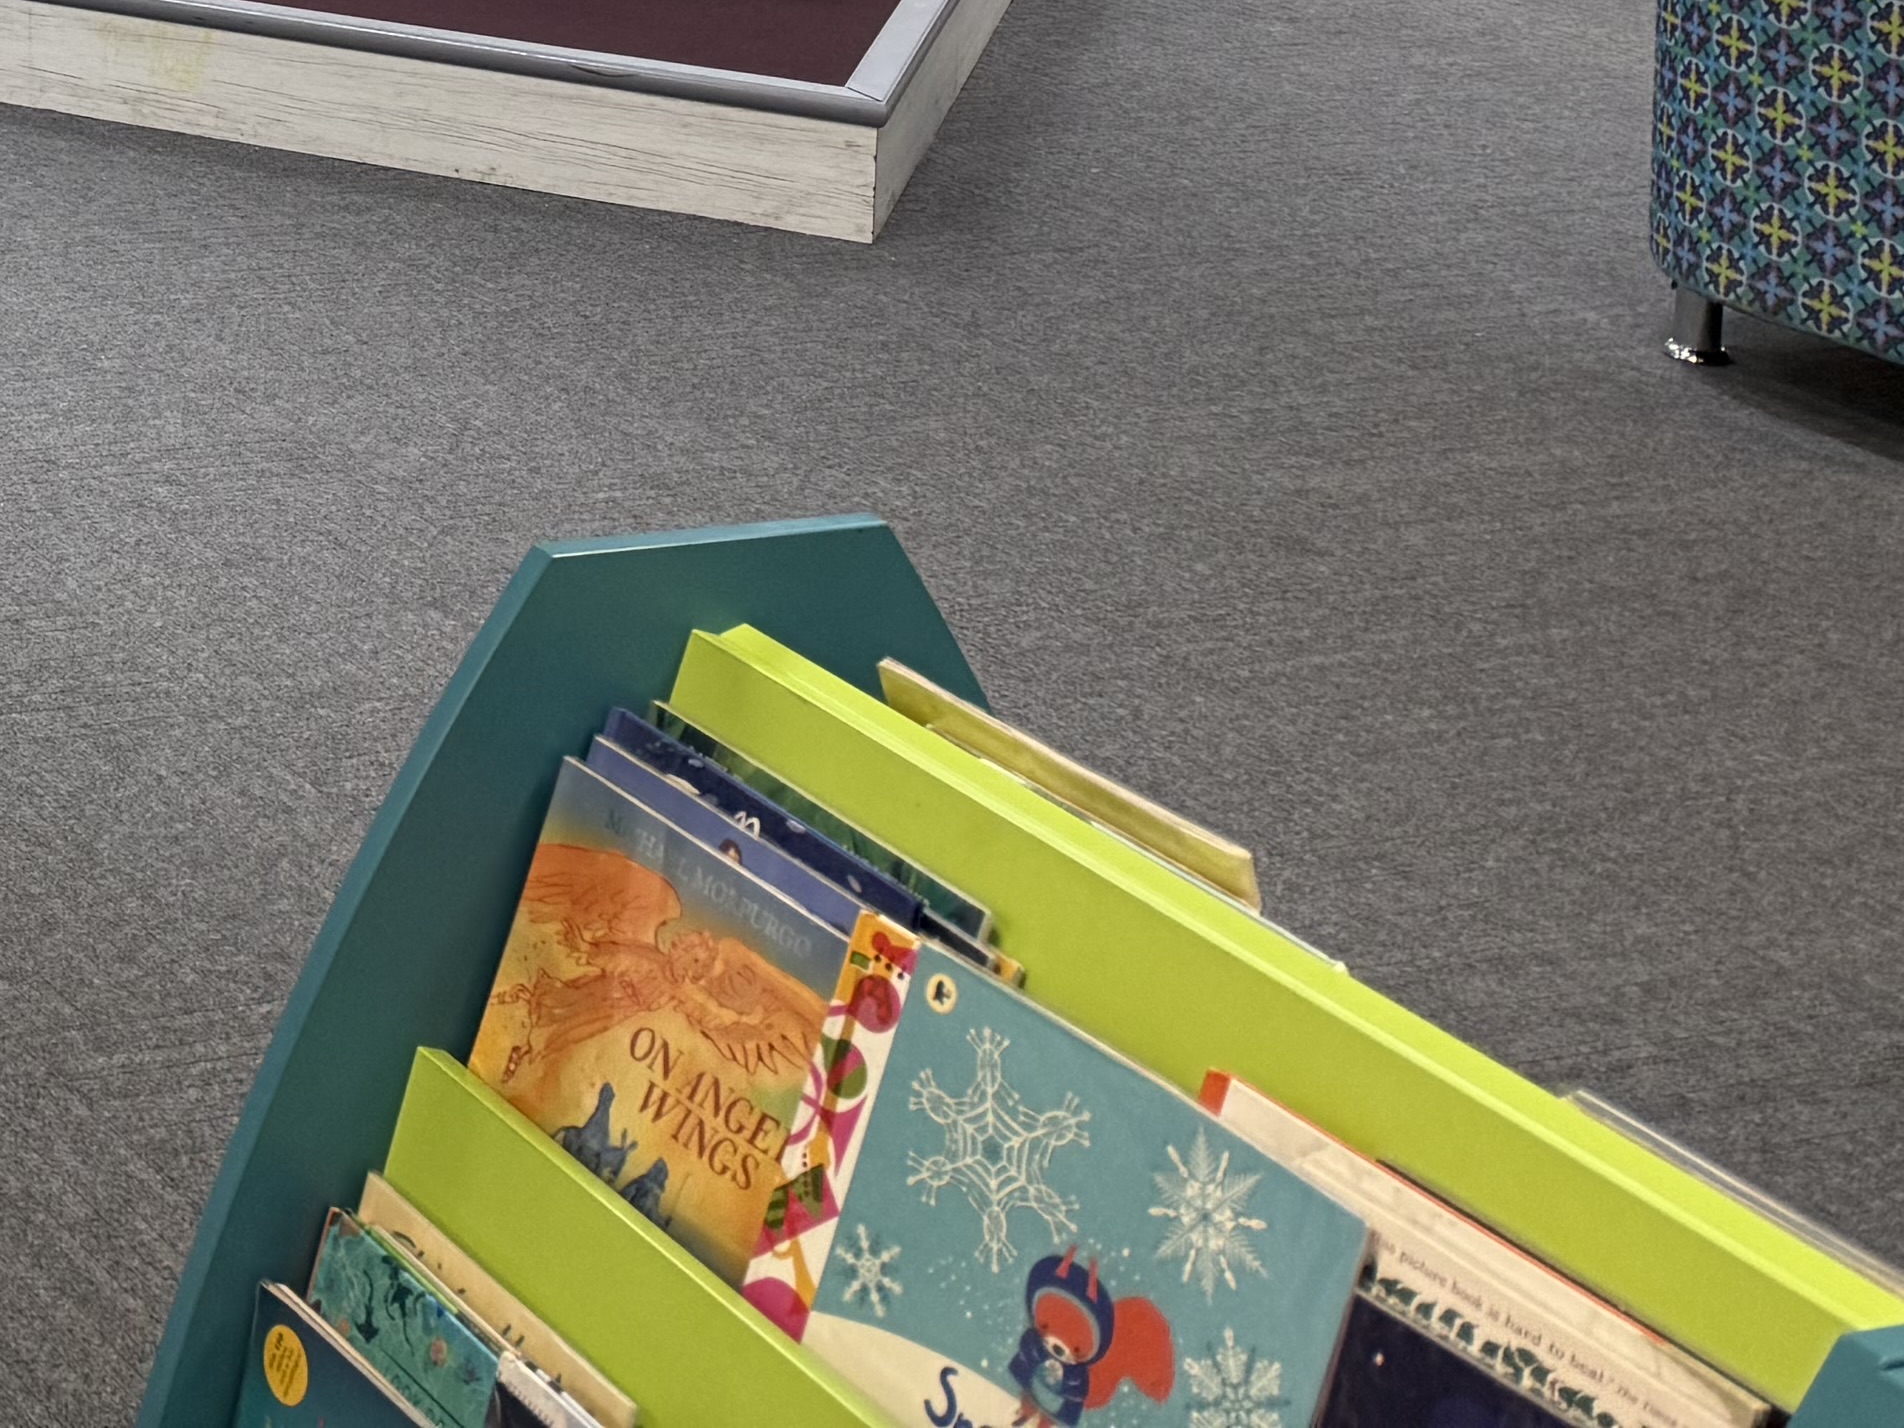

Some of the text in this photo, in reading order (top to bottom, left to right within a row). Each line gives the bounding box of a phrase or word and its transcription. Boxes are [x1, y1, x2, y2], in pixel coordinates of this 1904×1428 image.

[629, 1026, 685, 1082] ON
[639, 1079, 762, 1193] WINGS
[1399, 1251, 1448, 1289] picture
[1450, 1279, 1483, 1311] book
[1505, 1312, 1543, 1346] hard
[1549, 1342, 1567, 1361] to
